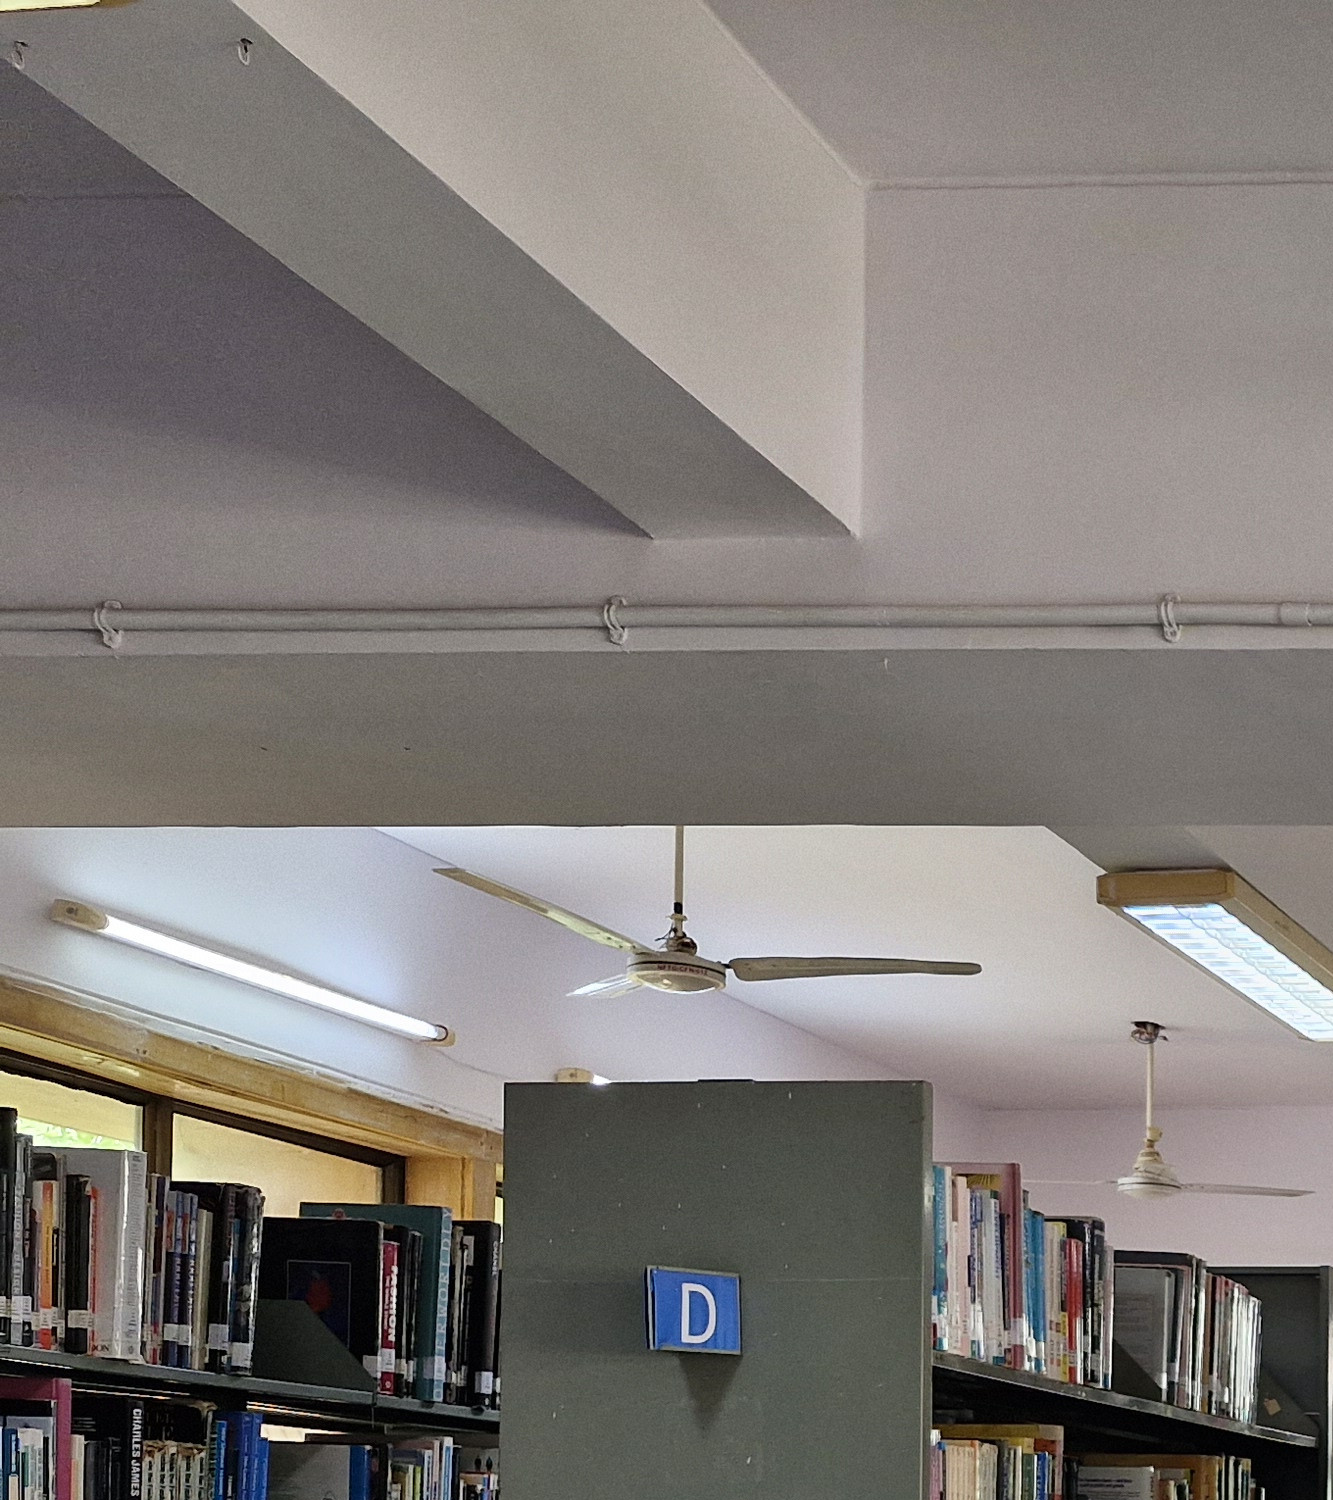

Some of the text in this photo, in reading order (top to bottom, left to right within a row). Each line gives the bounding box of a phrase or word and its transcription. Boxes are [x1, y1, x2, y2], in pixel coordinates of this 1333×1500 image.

[680, 1282, 717, 1344] D
[130, 1408, 142, 1497] CHARLES JAMES
